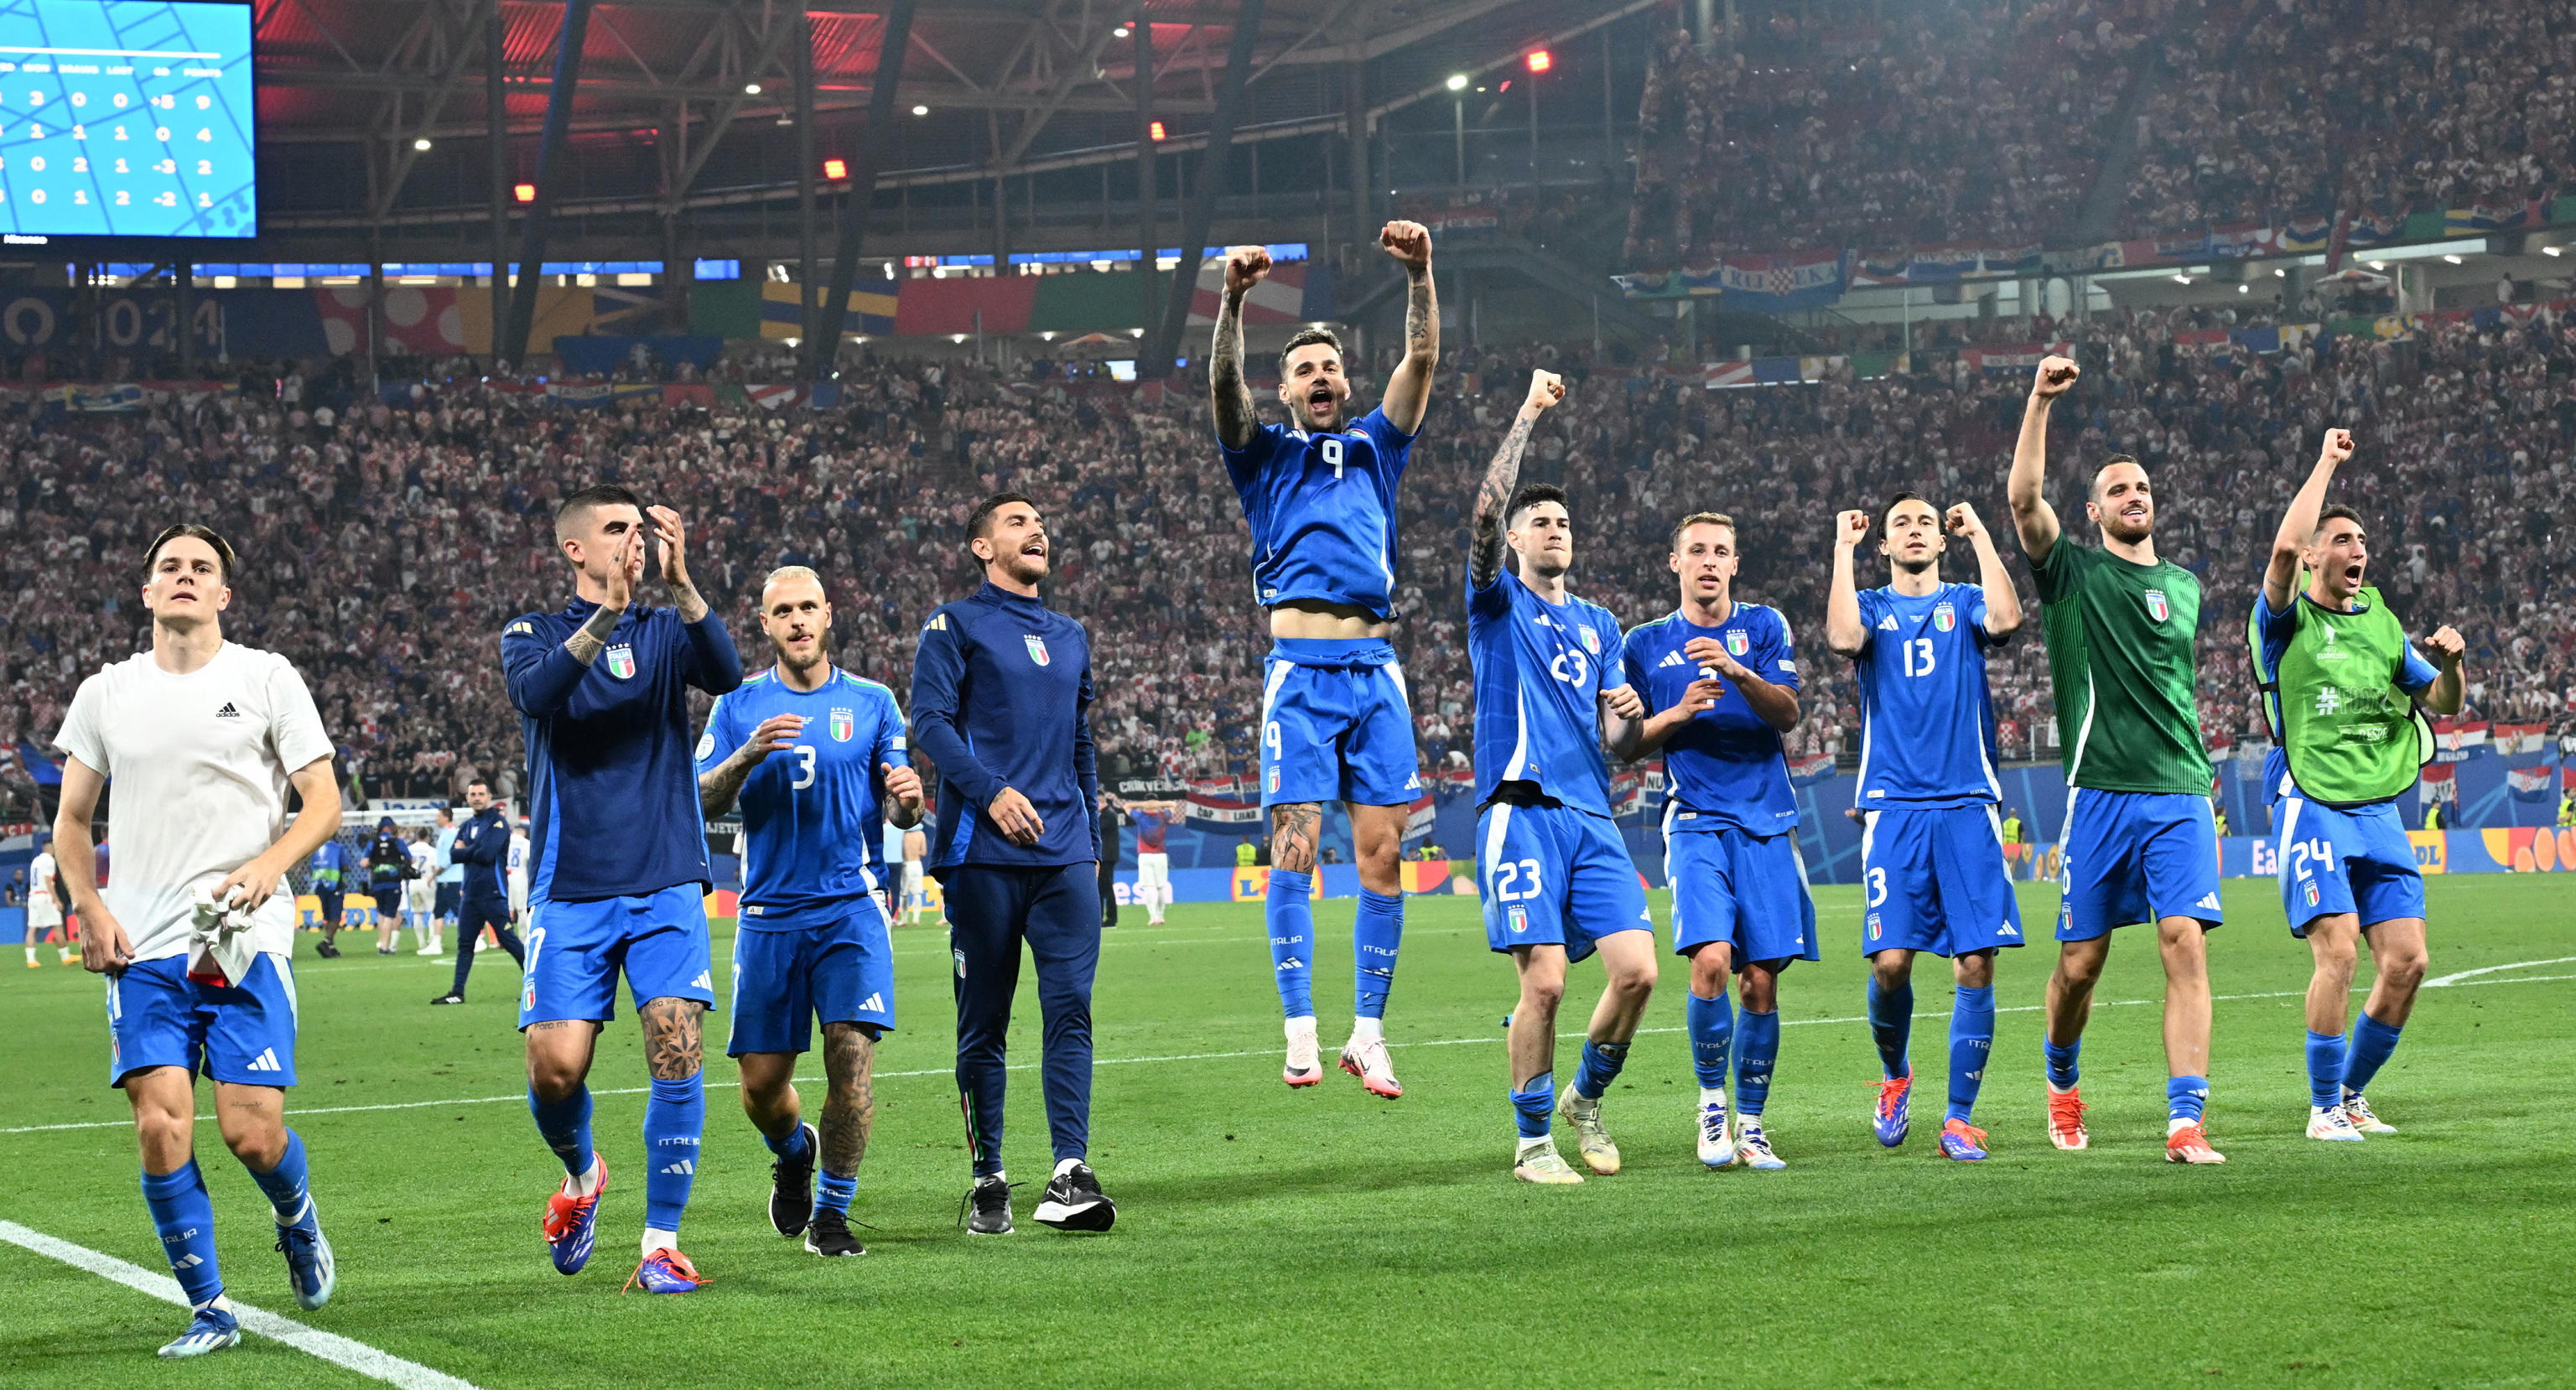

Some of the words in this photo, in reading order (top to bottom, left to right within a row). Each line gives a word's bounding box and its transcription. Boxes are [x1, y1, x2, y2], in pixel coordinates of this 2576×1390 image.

[29, 91, 44, 106] 3
[71, 92, 86, 107] 0
[113, 93, 128, 108] 0
[195, 96, 210, 110] 9
[30, 123, 45, 139] 1
[73, 125, 87, 140] 1
[114, 126, 129, 140] 1
[156, 127, 171, 142] 0
[196, 127, 211, 143] 4
[31, 156, 46, 171] 0
[73, 157, 88, 173] 2
[115, 158, 130, 174] 1
[152, 159, 176, 174] -3
[198, 160, 213, 174] 2
[31, 189, 46, 204] 0
[74, 189, 89, 205] 1
[116, 190, 131, 205] 2
[153, 191, 176, 206] -2
[198, 192, 213, 207] 1
[1322, 440, 1343, 479] 9
[1551, 643, 1587, 687] 23
[1903, 638, 1935, 677] 13
[1266, 721, 1282, 760] 9
[792, 745, 816, 789] 3
[2290, 838, 2334, 882] 24
[1496, 858, 1542, 902] 23
[1864, 867, 1888, 911] 13
